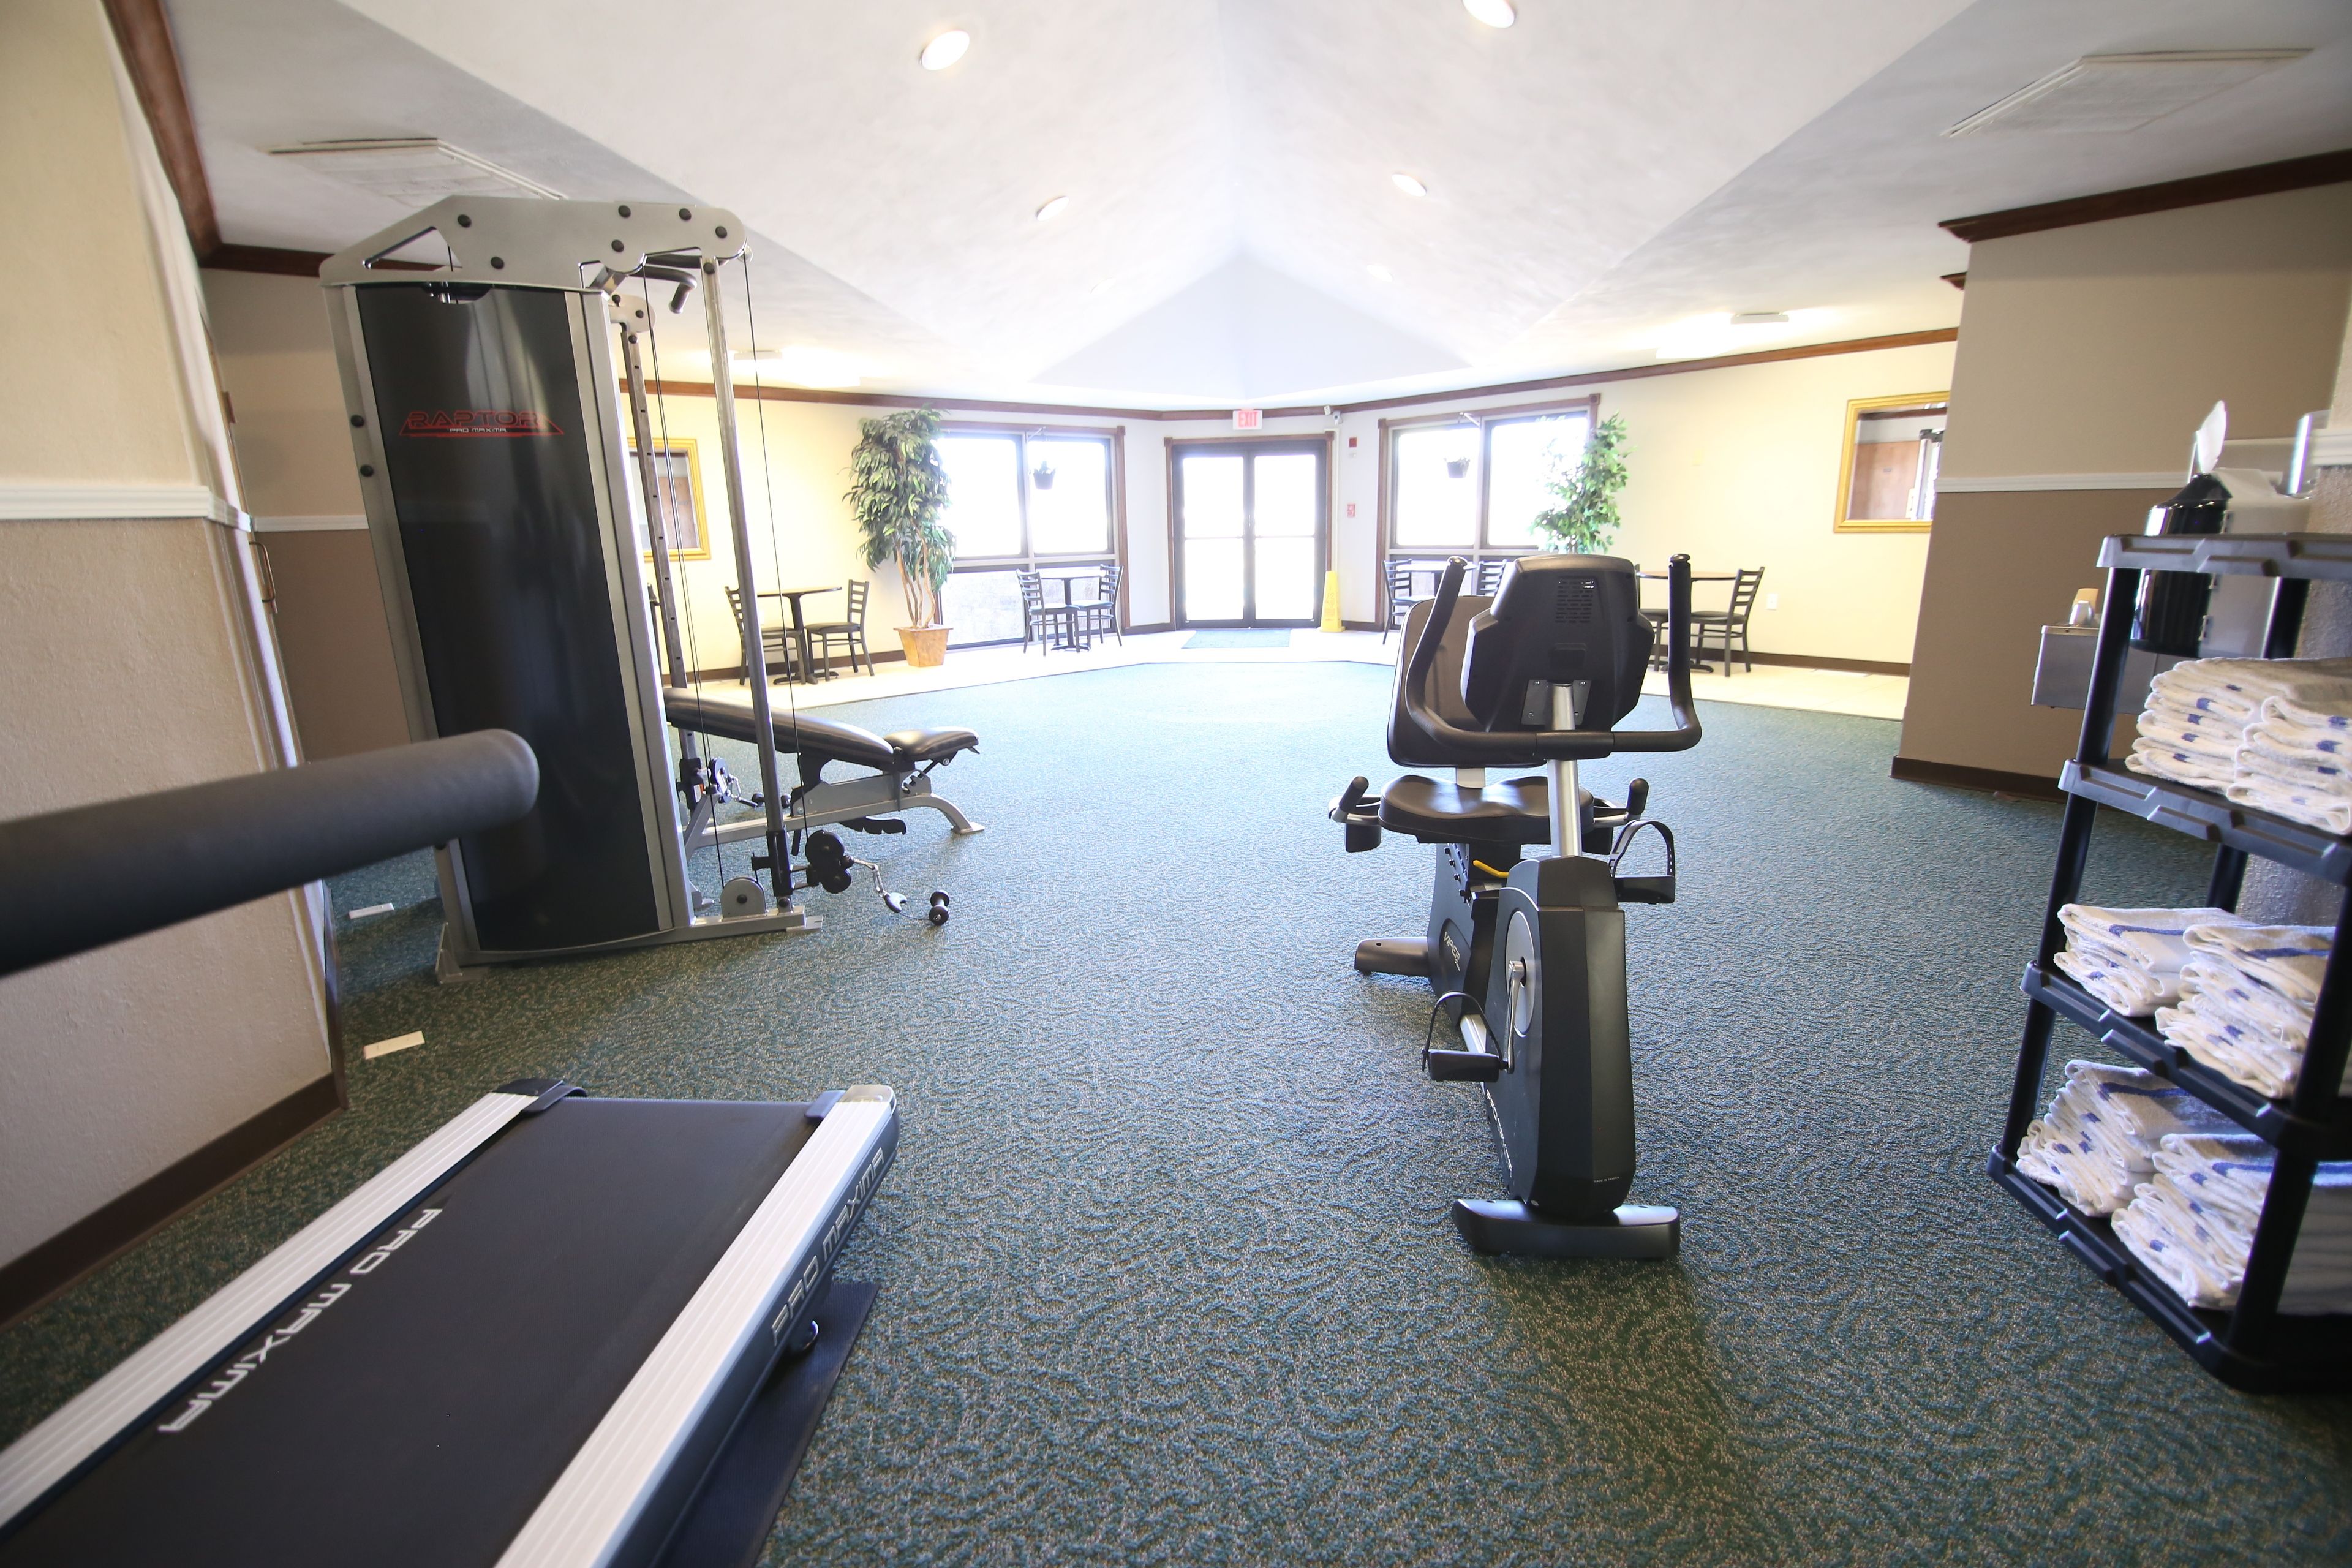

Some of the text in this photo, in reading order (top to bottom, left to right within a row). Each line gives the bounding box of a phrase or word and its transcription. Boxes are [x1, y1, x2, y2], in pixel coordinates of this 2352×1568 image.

[409, 411, 541, 428] RAPTOR
[1238, 411, 1258, 427] EXIT
[1444, 932, 1460, 960] VIPER
[771, 1147, 884, 1346] PRO MAXIMA
[157, 1208, 443, 1431] PRO MAXIMA
